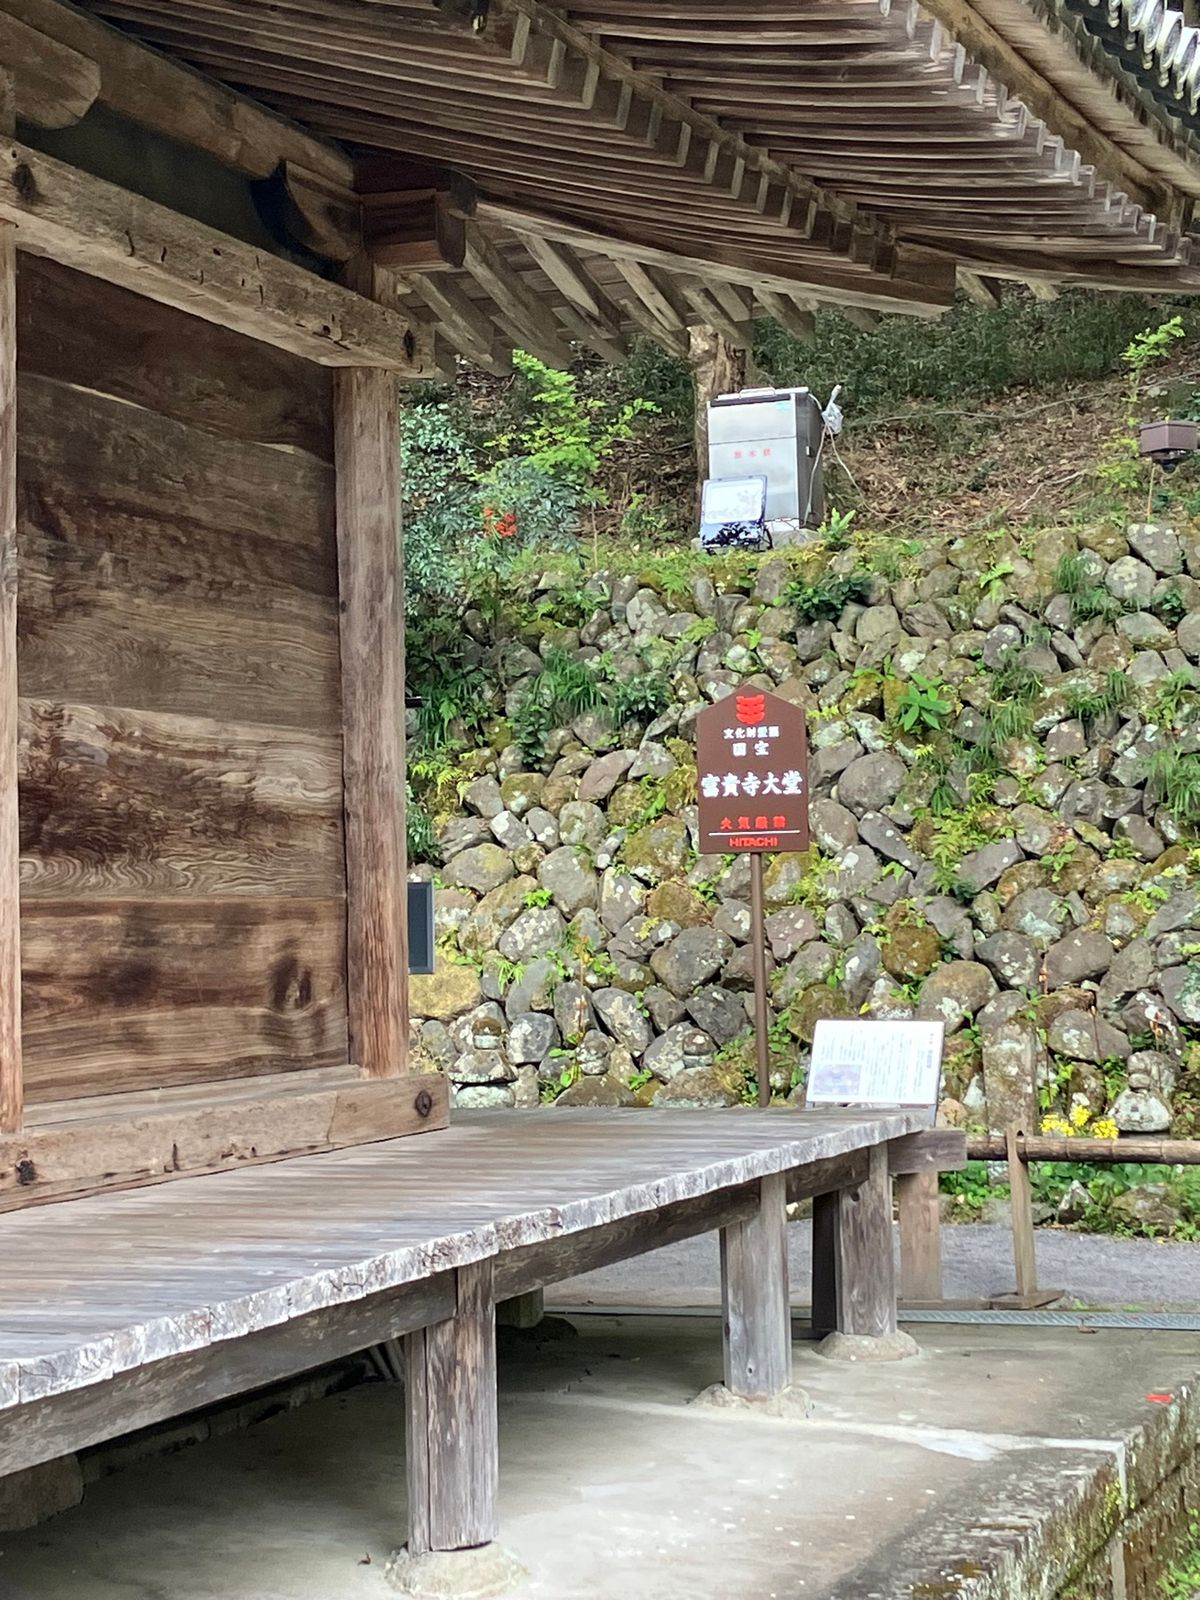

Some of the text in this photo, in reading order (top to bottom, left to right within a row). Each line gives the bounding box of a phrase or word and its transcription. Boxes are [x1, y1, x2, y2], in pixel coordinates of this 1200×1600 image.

[700, 769, 803, 798] 富貴寺大堂
[729, 836, 778, 847] HITACHI
